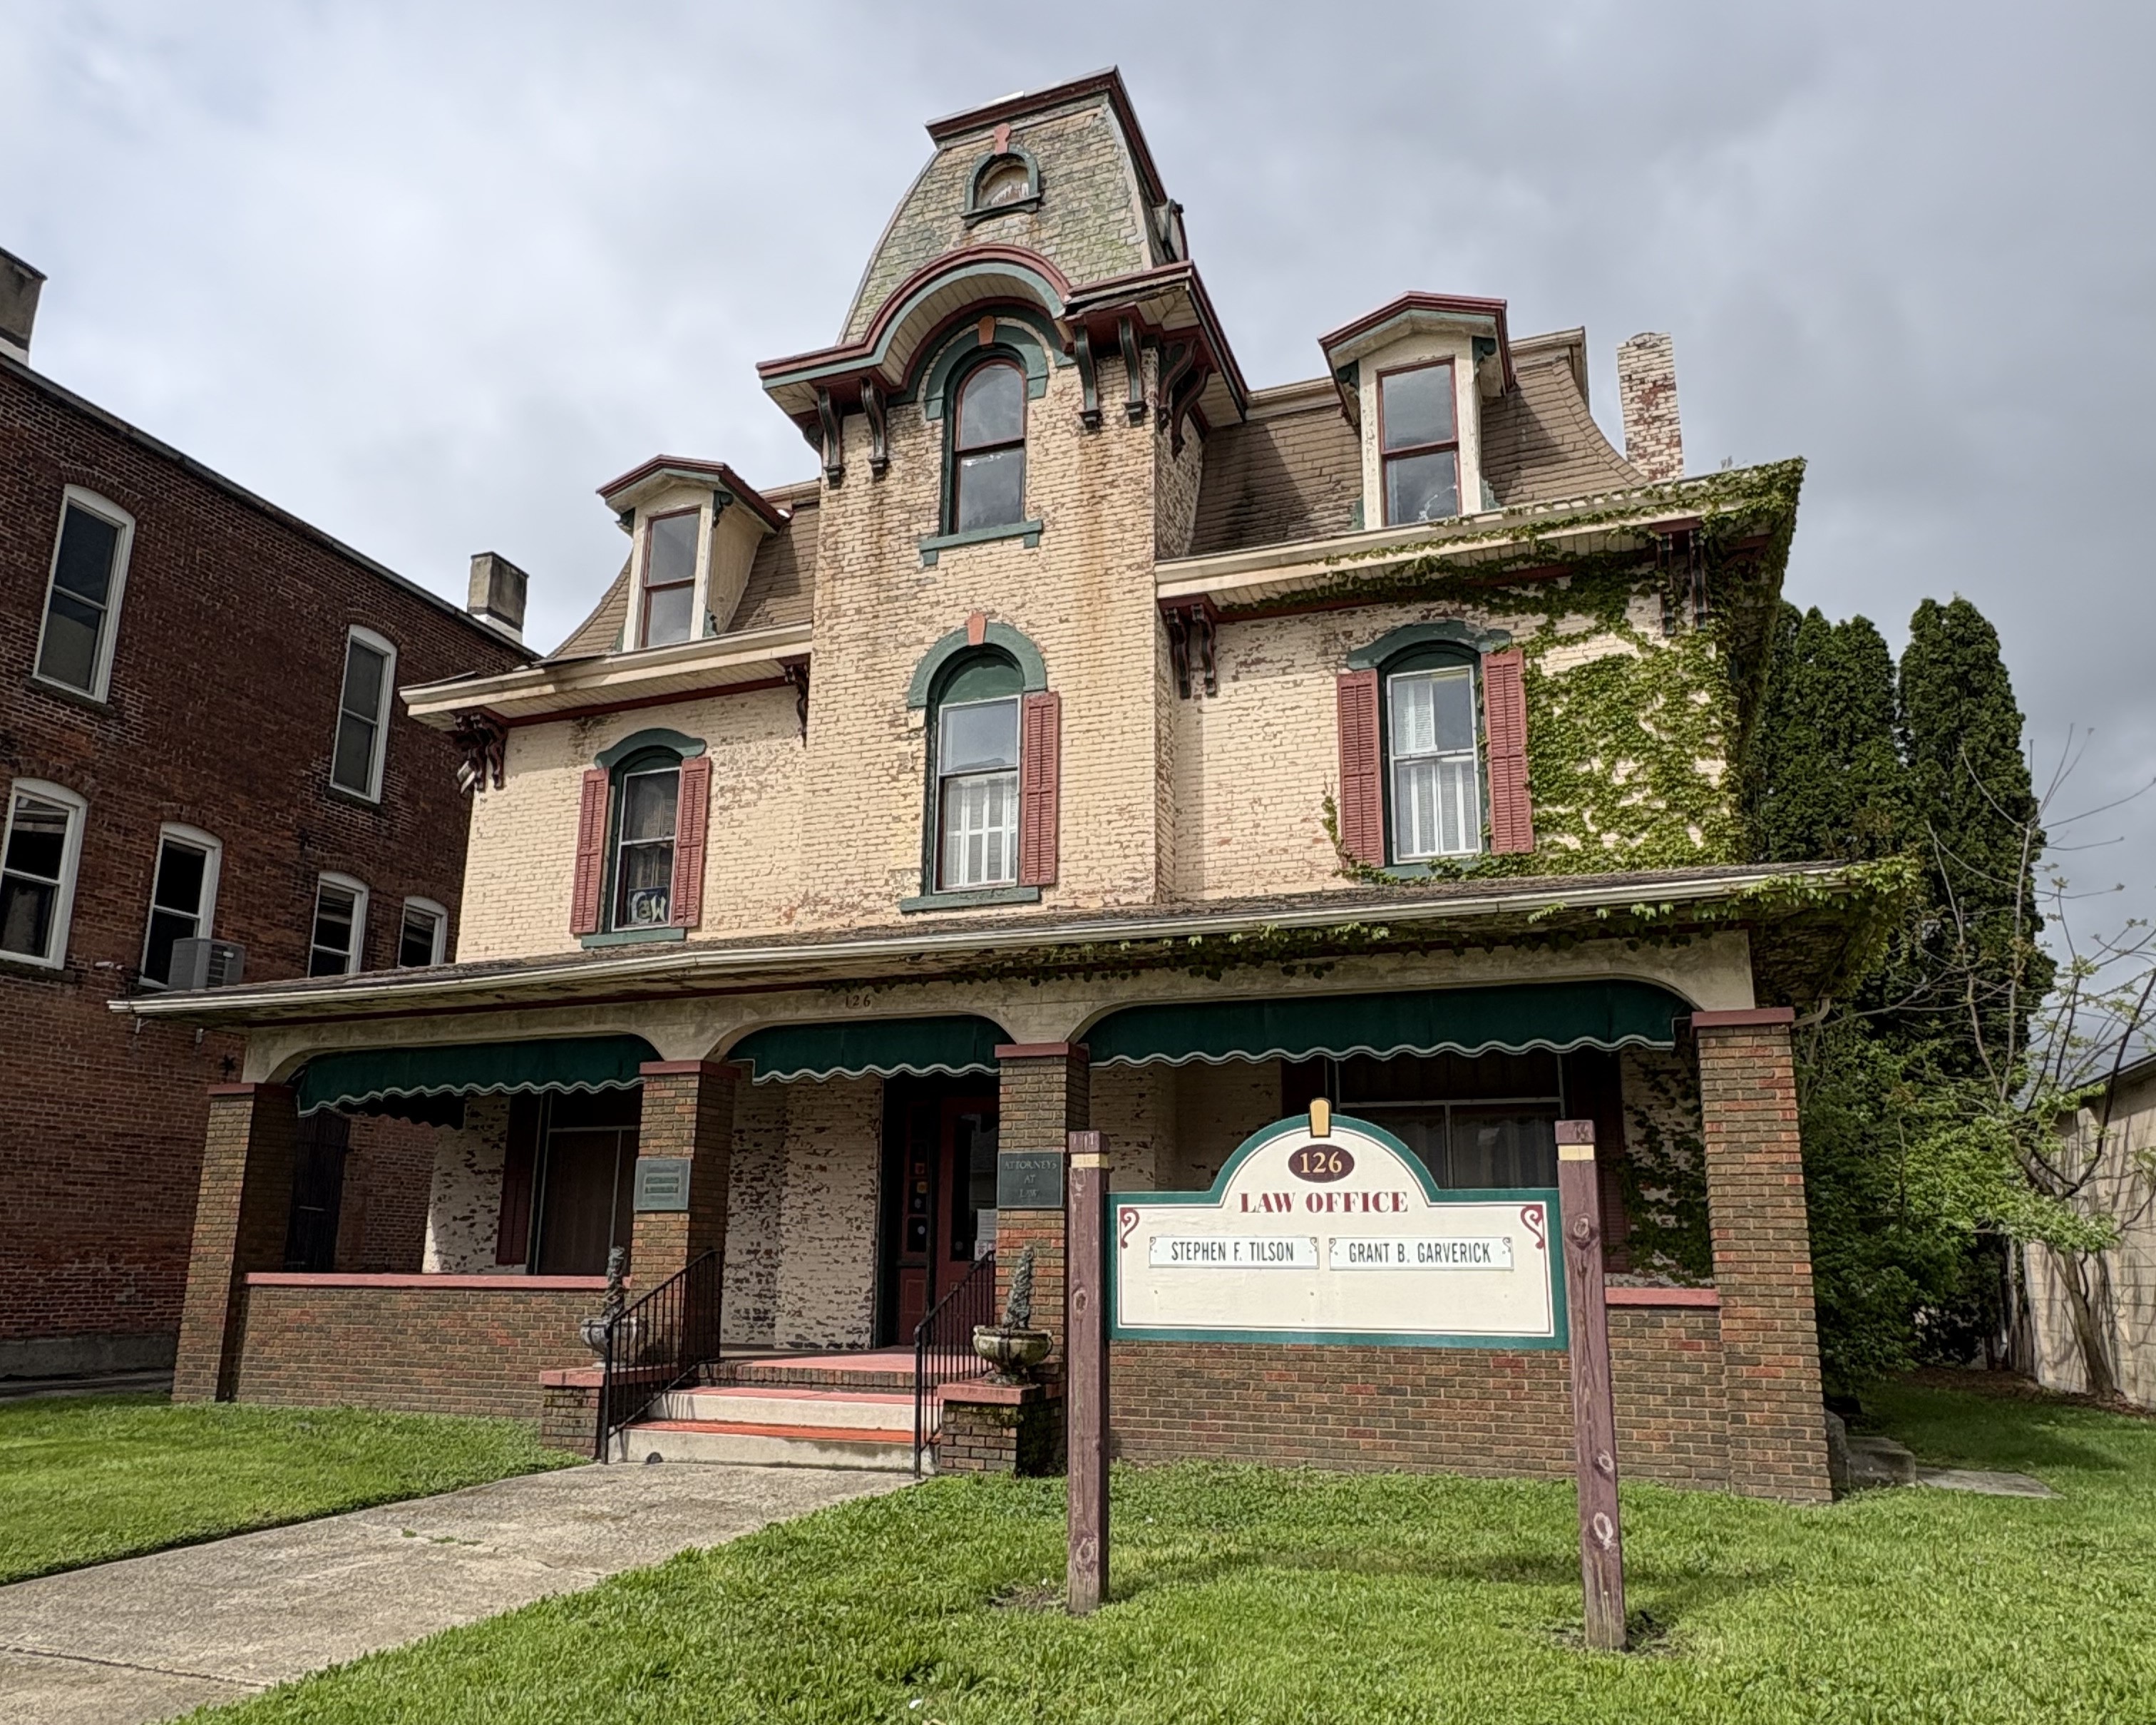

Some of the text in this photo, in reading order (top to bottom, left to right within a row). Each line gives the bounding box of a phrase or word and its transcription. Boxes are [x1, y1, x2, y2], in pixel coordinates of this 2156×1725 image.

[845, 993, 871, 1007] 126
[1004, 1160, 1057, 1169] ATTORNEYS
[1300, 1151, 1343, 1174] 126
[1024, 1174, 1036, 1184] AT
[1020, 1188, 1040, 1198] LAW
[1239, 1191, 1409, 1213] LAW OFFICE
[1171, 1241, 1294, 1261] STEPHEN F. TILSON
[1349, 1242, 1492, 1263] GRANT B. GARVERICK
